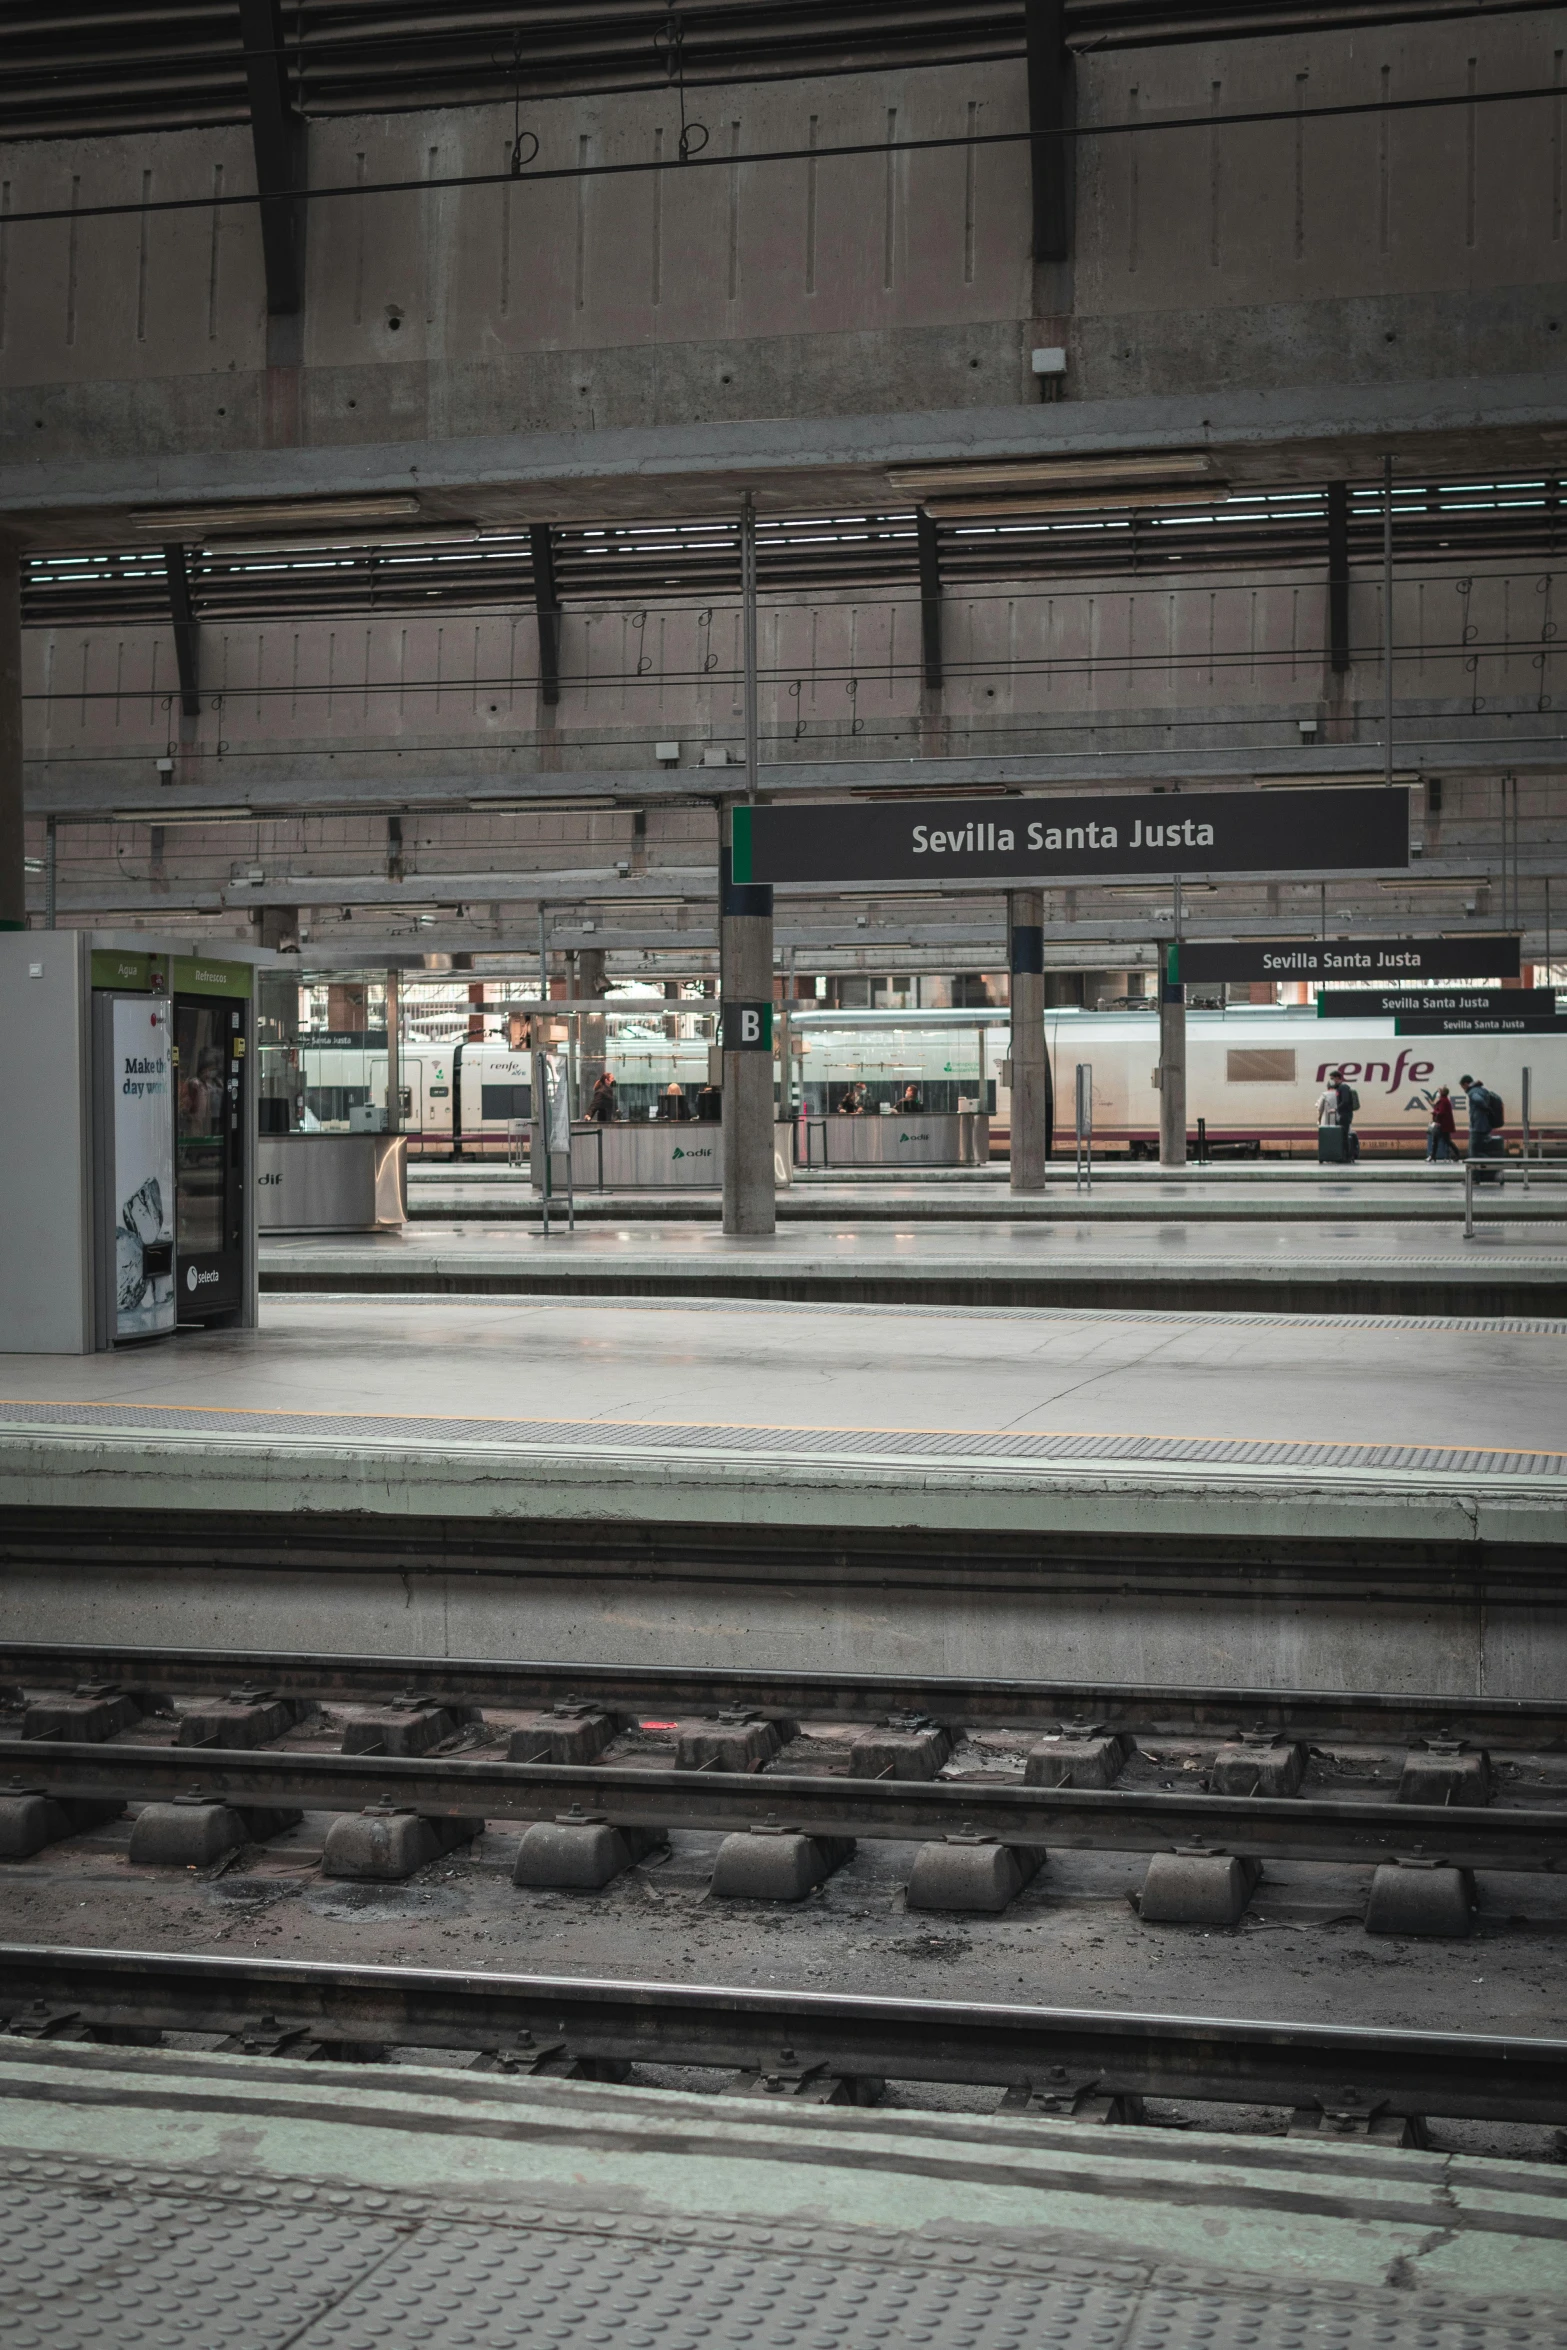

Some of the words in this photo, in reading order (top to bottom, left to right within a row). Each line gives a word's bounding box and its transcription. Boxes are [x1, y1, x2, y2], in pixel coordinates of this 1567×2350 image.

[912, 822, 1015, 853] Sevilla
[1027, 821, 1118, 850] Santa
[1129, 819, 1214, 848] Justa
[1263, 953, 1317, 969] Sevilla
[1323, 952, 1371, 968] Santa
[1376, 952, 1421, 967] Justa
[118, 964, 138, 978] Agua
[195, 970, 227, 983] Refrescos
[1382, 998, 1419, 1009] Sevilla
[1423, 997, 1457, 1009] Santa
[1459, 997, 1489, 1008] Justa
[741, 1010, 760, 1042] B
[1443, 1020, 1472, 1030] Sevilla
[1474, 1020, 1500, 1029] Santa
[1501, 1019, 1525, 1029] Justa
[125, 1057, 155, 1074] Make
[490, 1061, 519, 1072] renfe
[1315, 1048, 1435, 1095] renfe
[123, 1078, 145, 1100] day
[910, 1133, 930, 1141] adif
[686, 1148, 713, 1157] adif
[258, 1173, 284, 1186] dif
[198, 1270, 219, 1283] selecta
